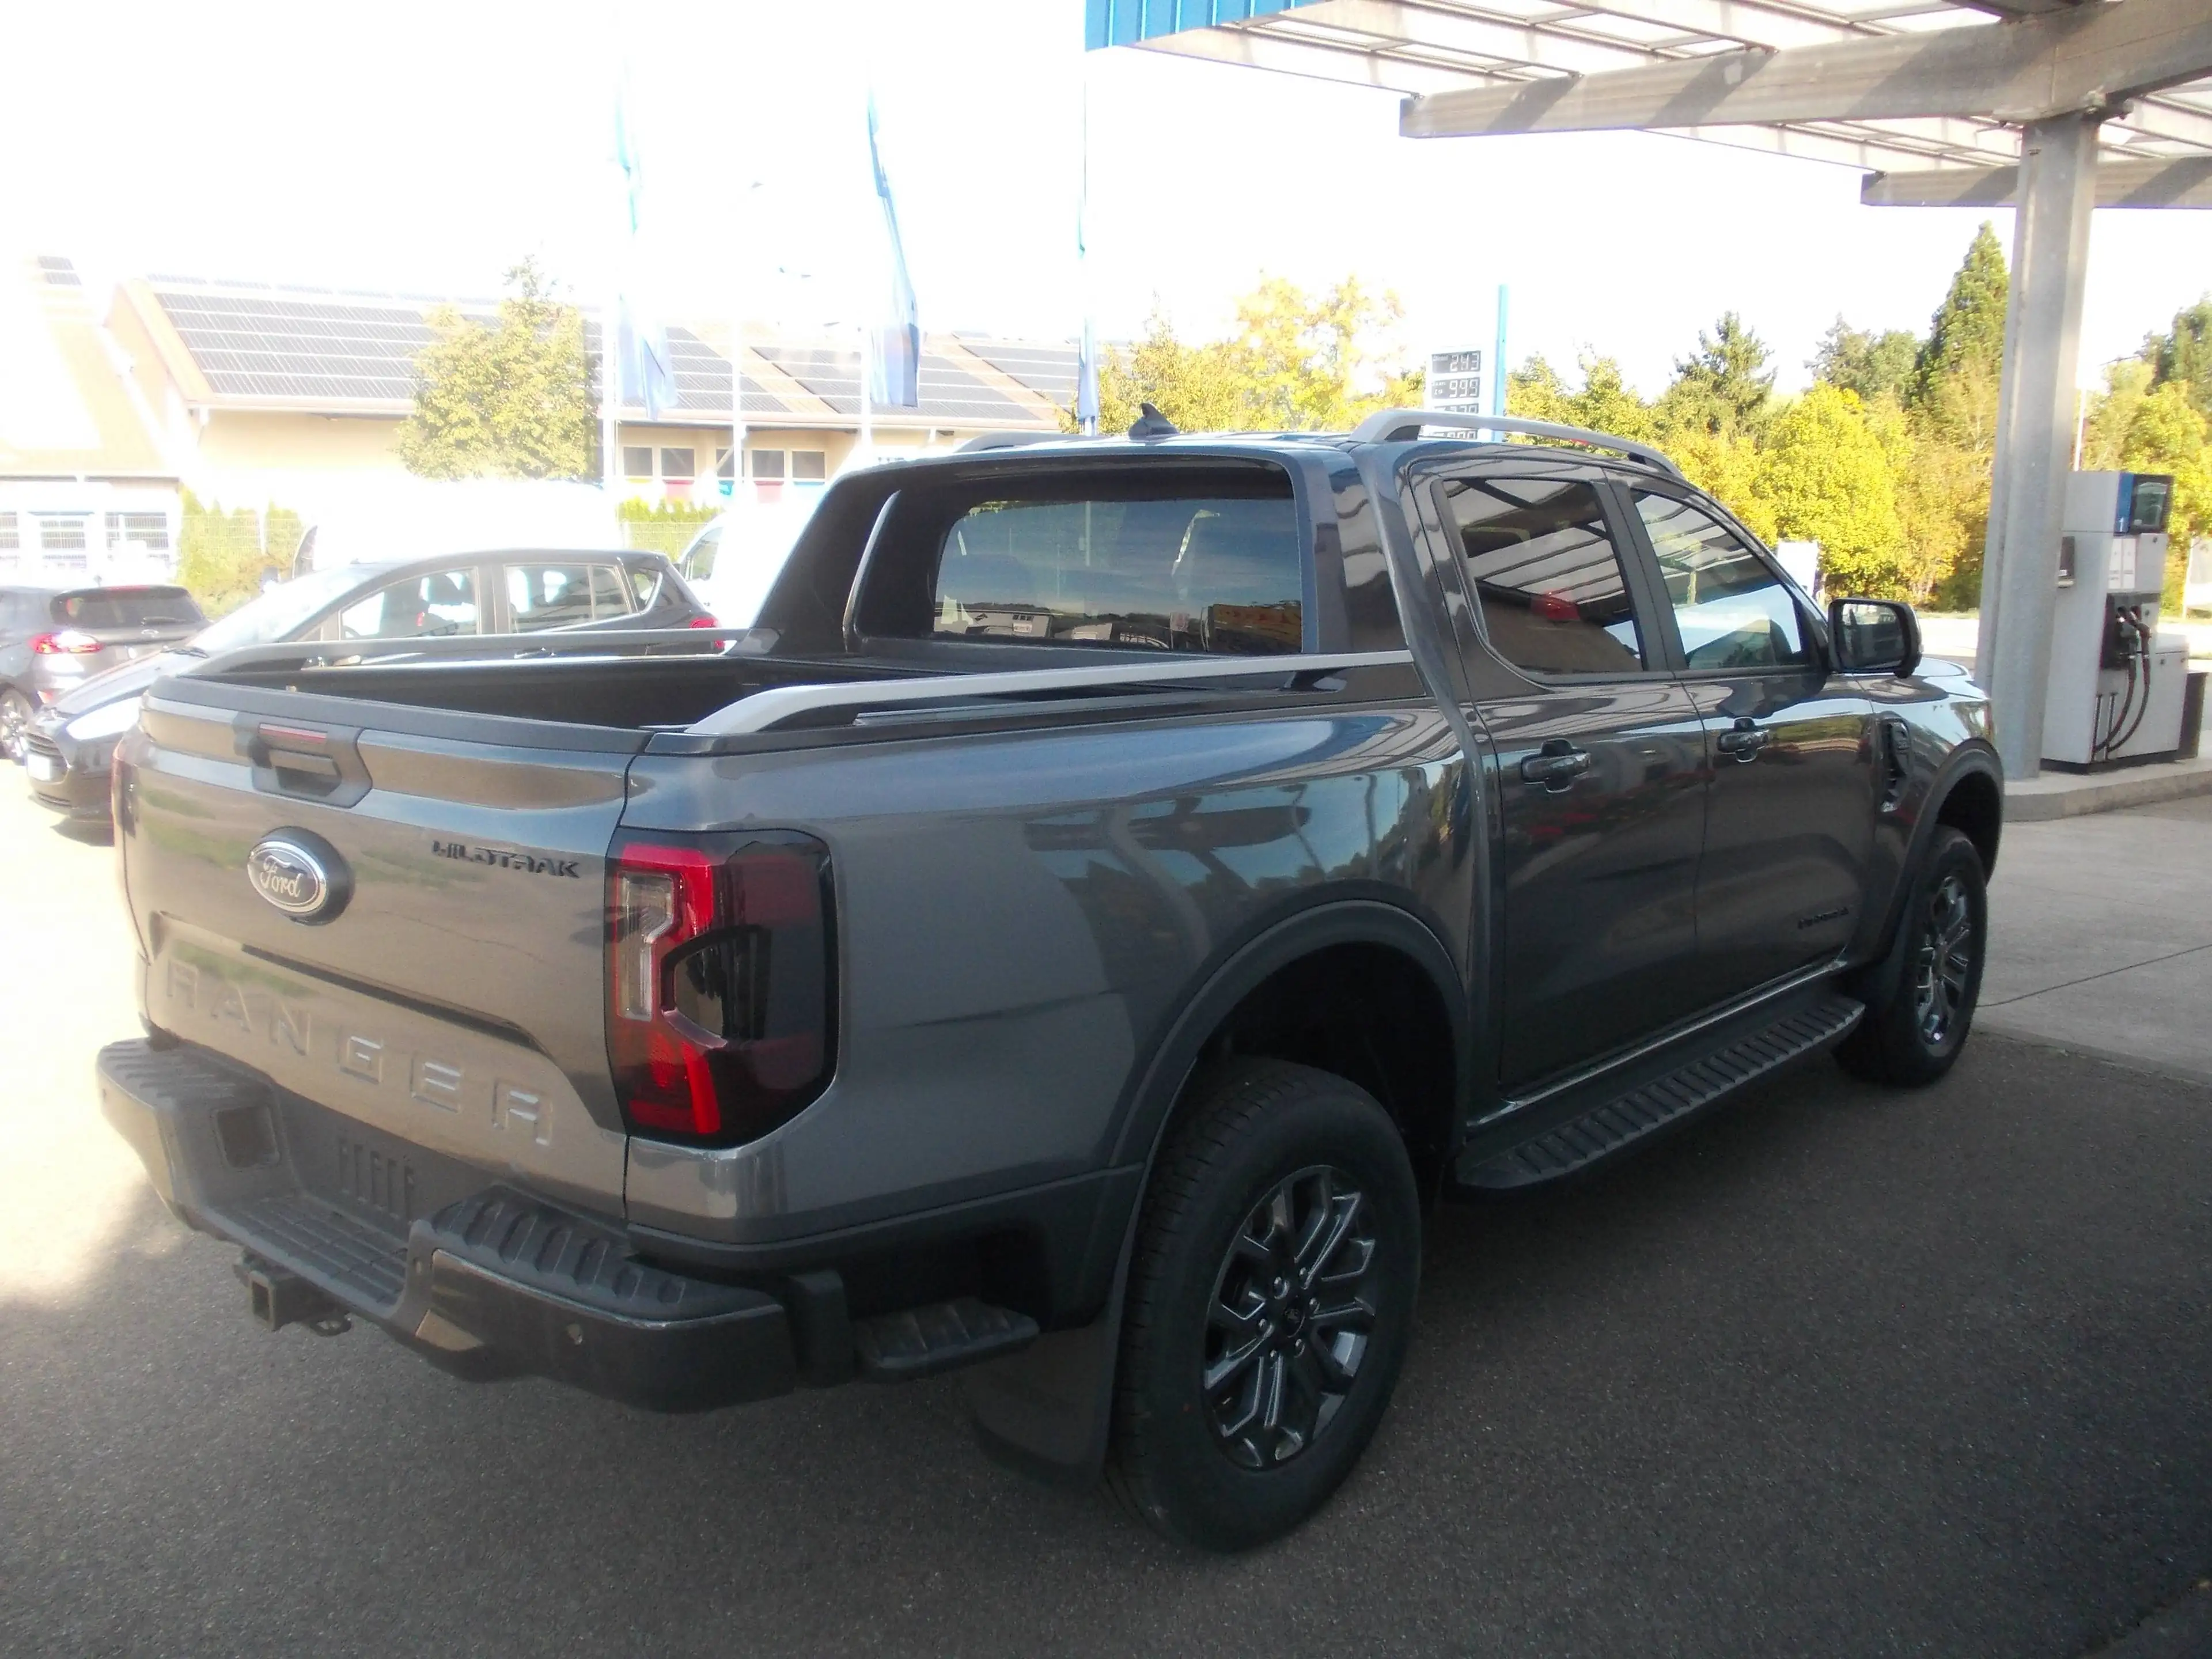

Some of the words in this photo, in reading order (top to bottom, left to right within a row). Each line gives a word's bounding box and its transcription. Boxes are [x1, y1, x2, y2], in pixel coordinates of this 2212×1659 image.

[1449, 378, 1479, 397] 999
[260, 855, 304, 897] Ford
[164, 957, 555, 1146] RANGER
